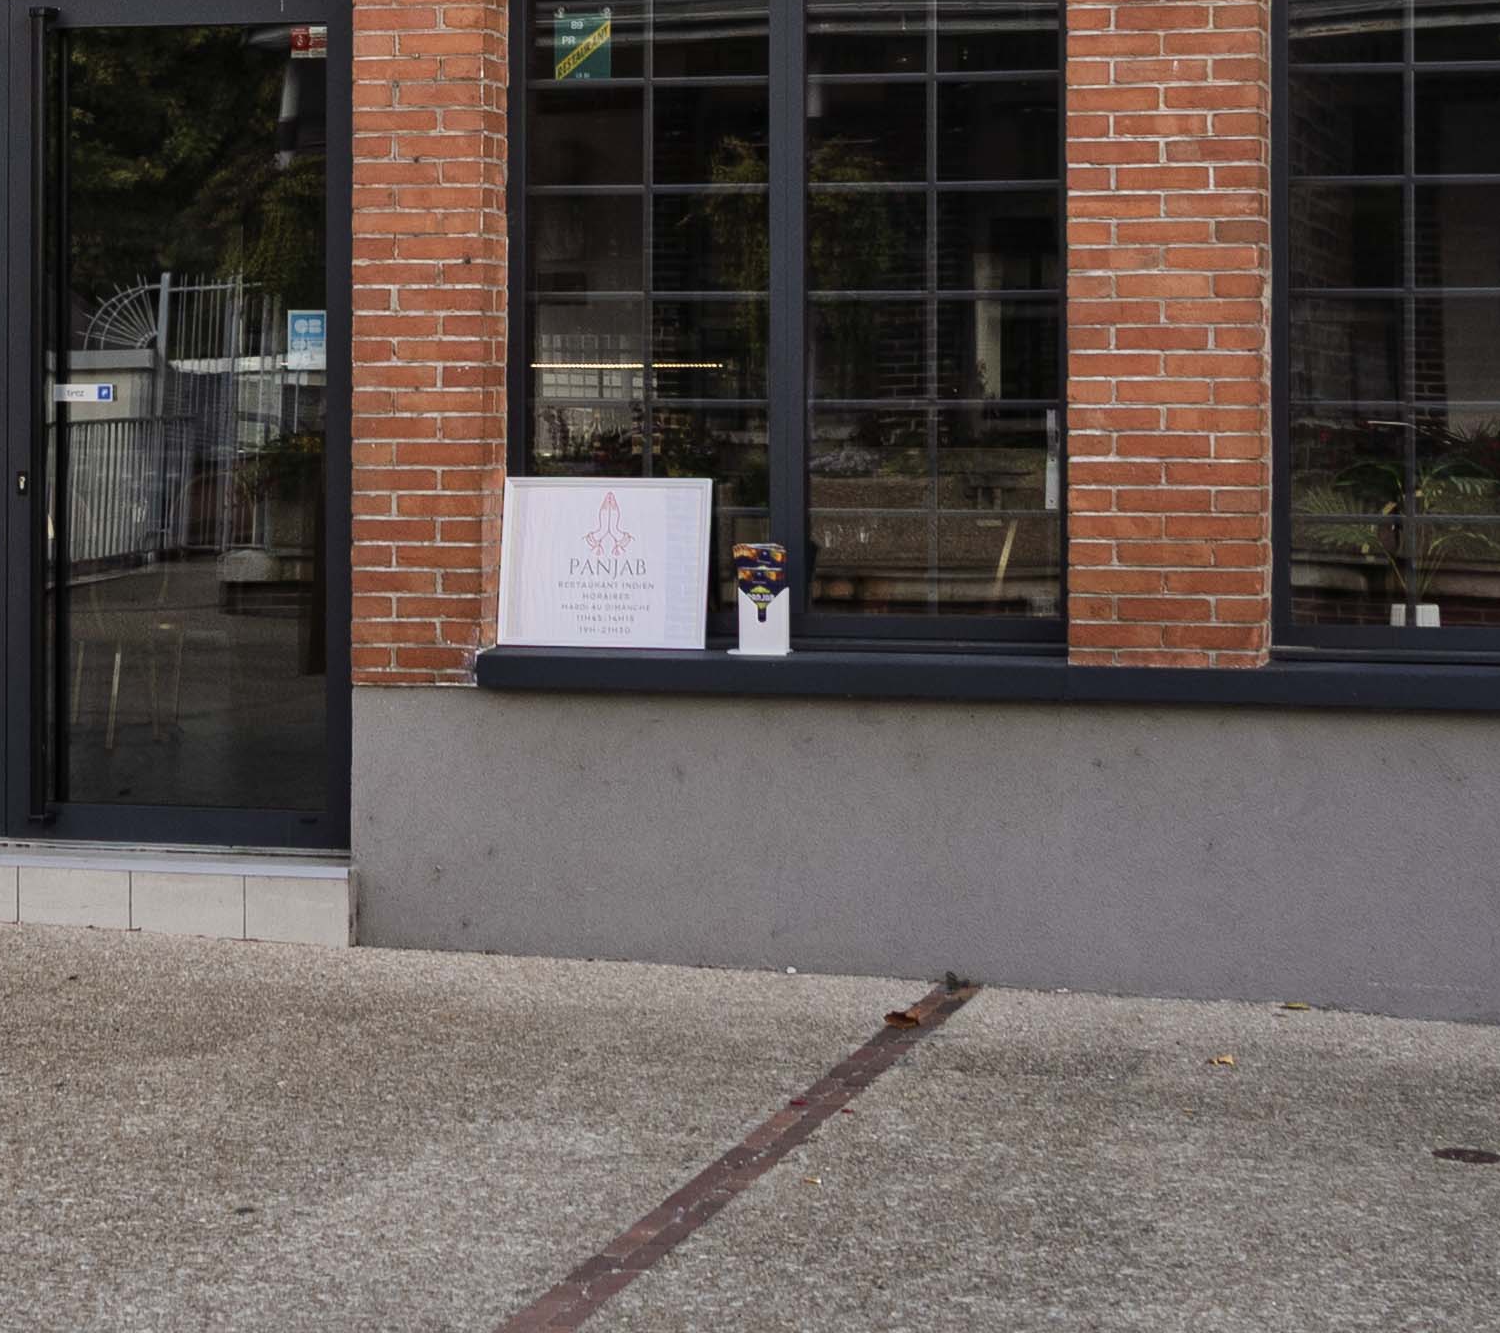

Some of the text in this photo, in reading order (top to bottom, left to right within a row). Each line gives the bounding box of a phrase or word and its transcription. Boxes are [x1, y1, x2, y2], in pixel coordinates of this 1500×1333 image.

[569, 557, 647, 580] PANJAB
[558, 580, 655, 590] RESTAURANT INDIEN
